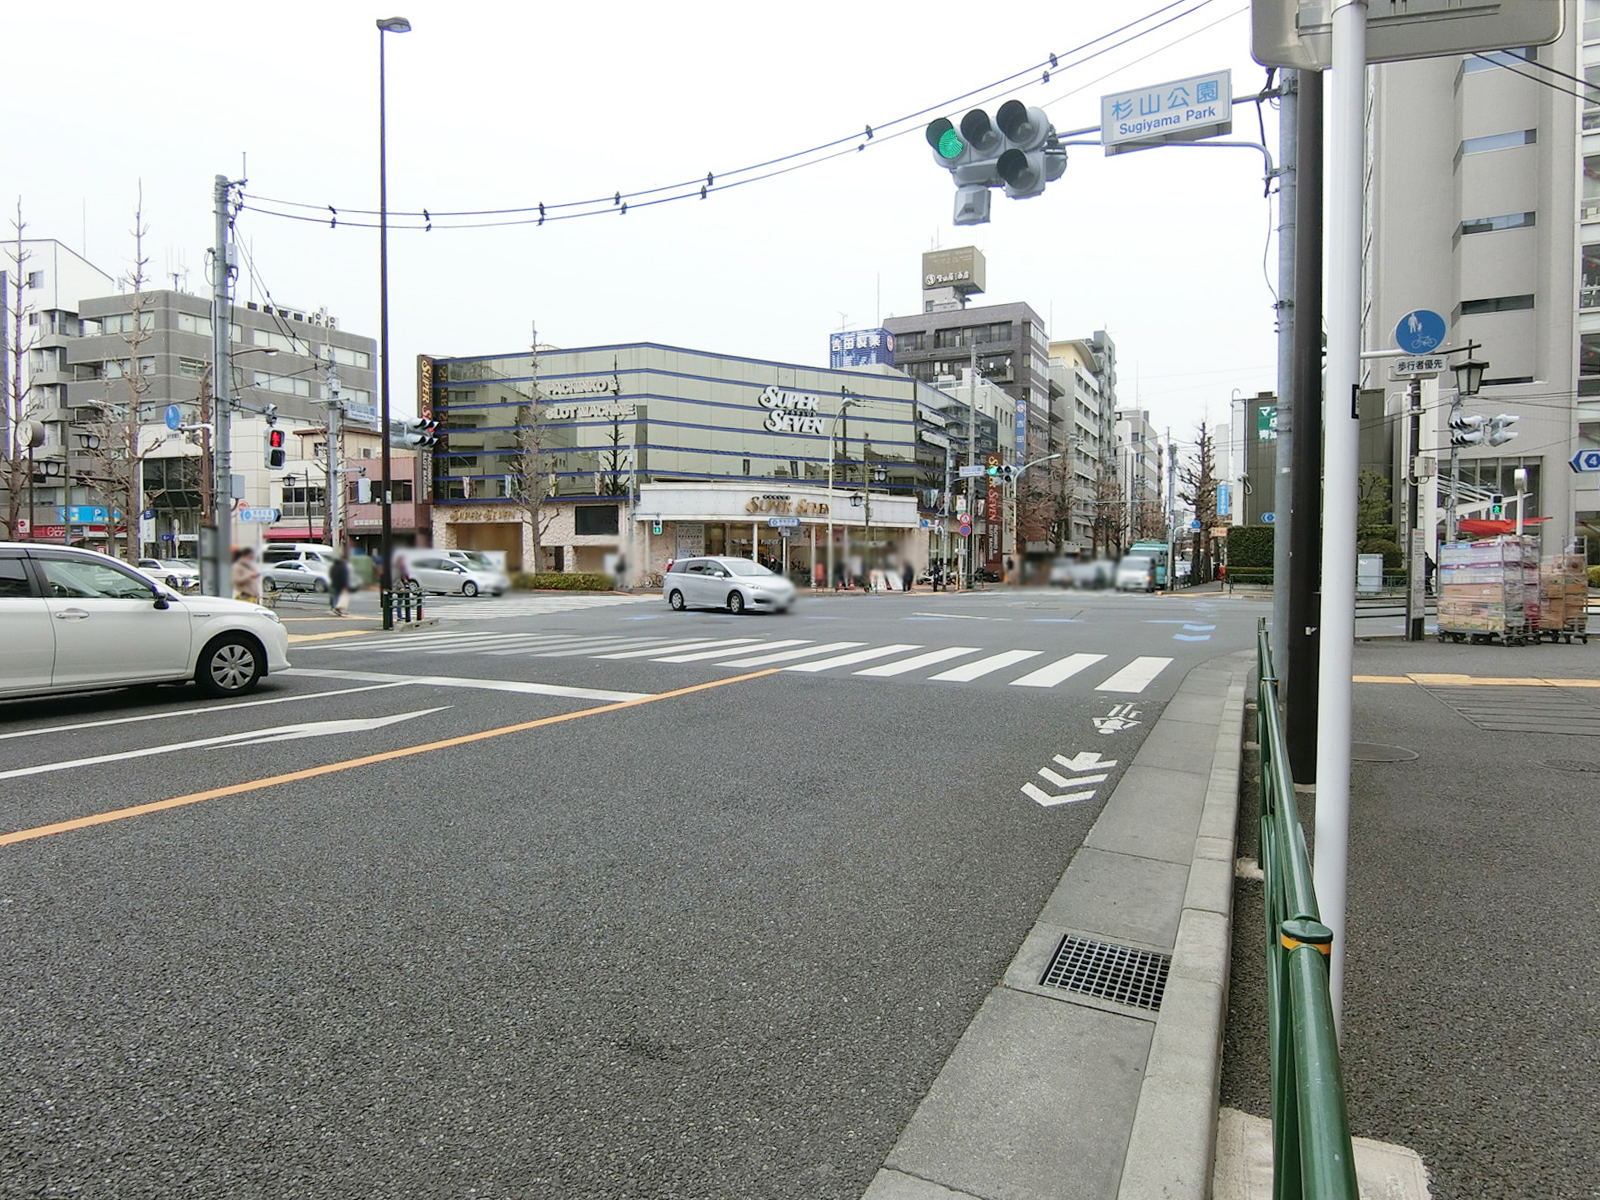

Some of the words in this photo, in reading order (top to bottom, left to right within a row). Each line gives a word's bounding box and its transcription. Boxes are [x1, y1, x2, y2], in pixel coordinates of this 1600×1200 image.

[1111, 80, 1218, 121] 杉山公園
[1119, 114, 1181, 135] Sugiyama
[1186, 106, 1216, 121] Park
[1398, 359, 1443, 372] 歩行者優先
[421, 360, 432, 403] SUPER
[547, 379, 608, 395] PACHINKO
[758, 386, 820, 411] SUPER
[545, 407, 577, 420] SLOT
[577, 403, 636, 418] MACHINE
[764, 410, 826, 434] SEVEN
[1589, 456, 1597, 466] 4
[988, 489, 999, 521] SEVEN
